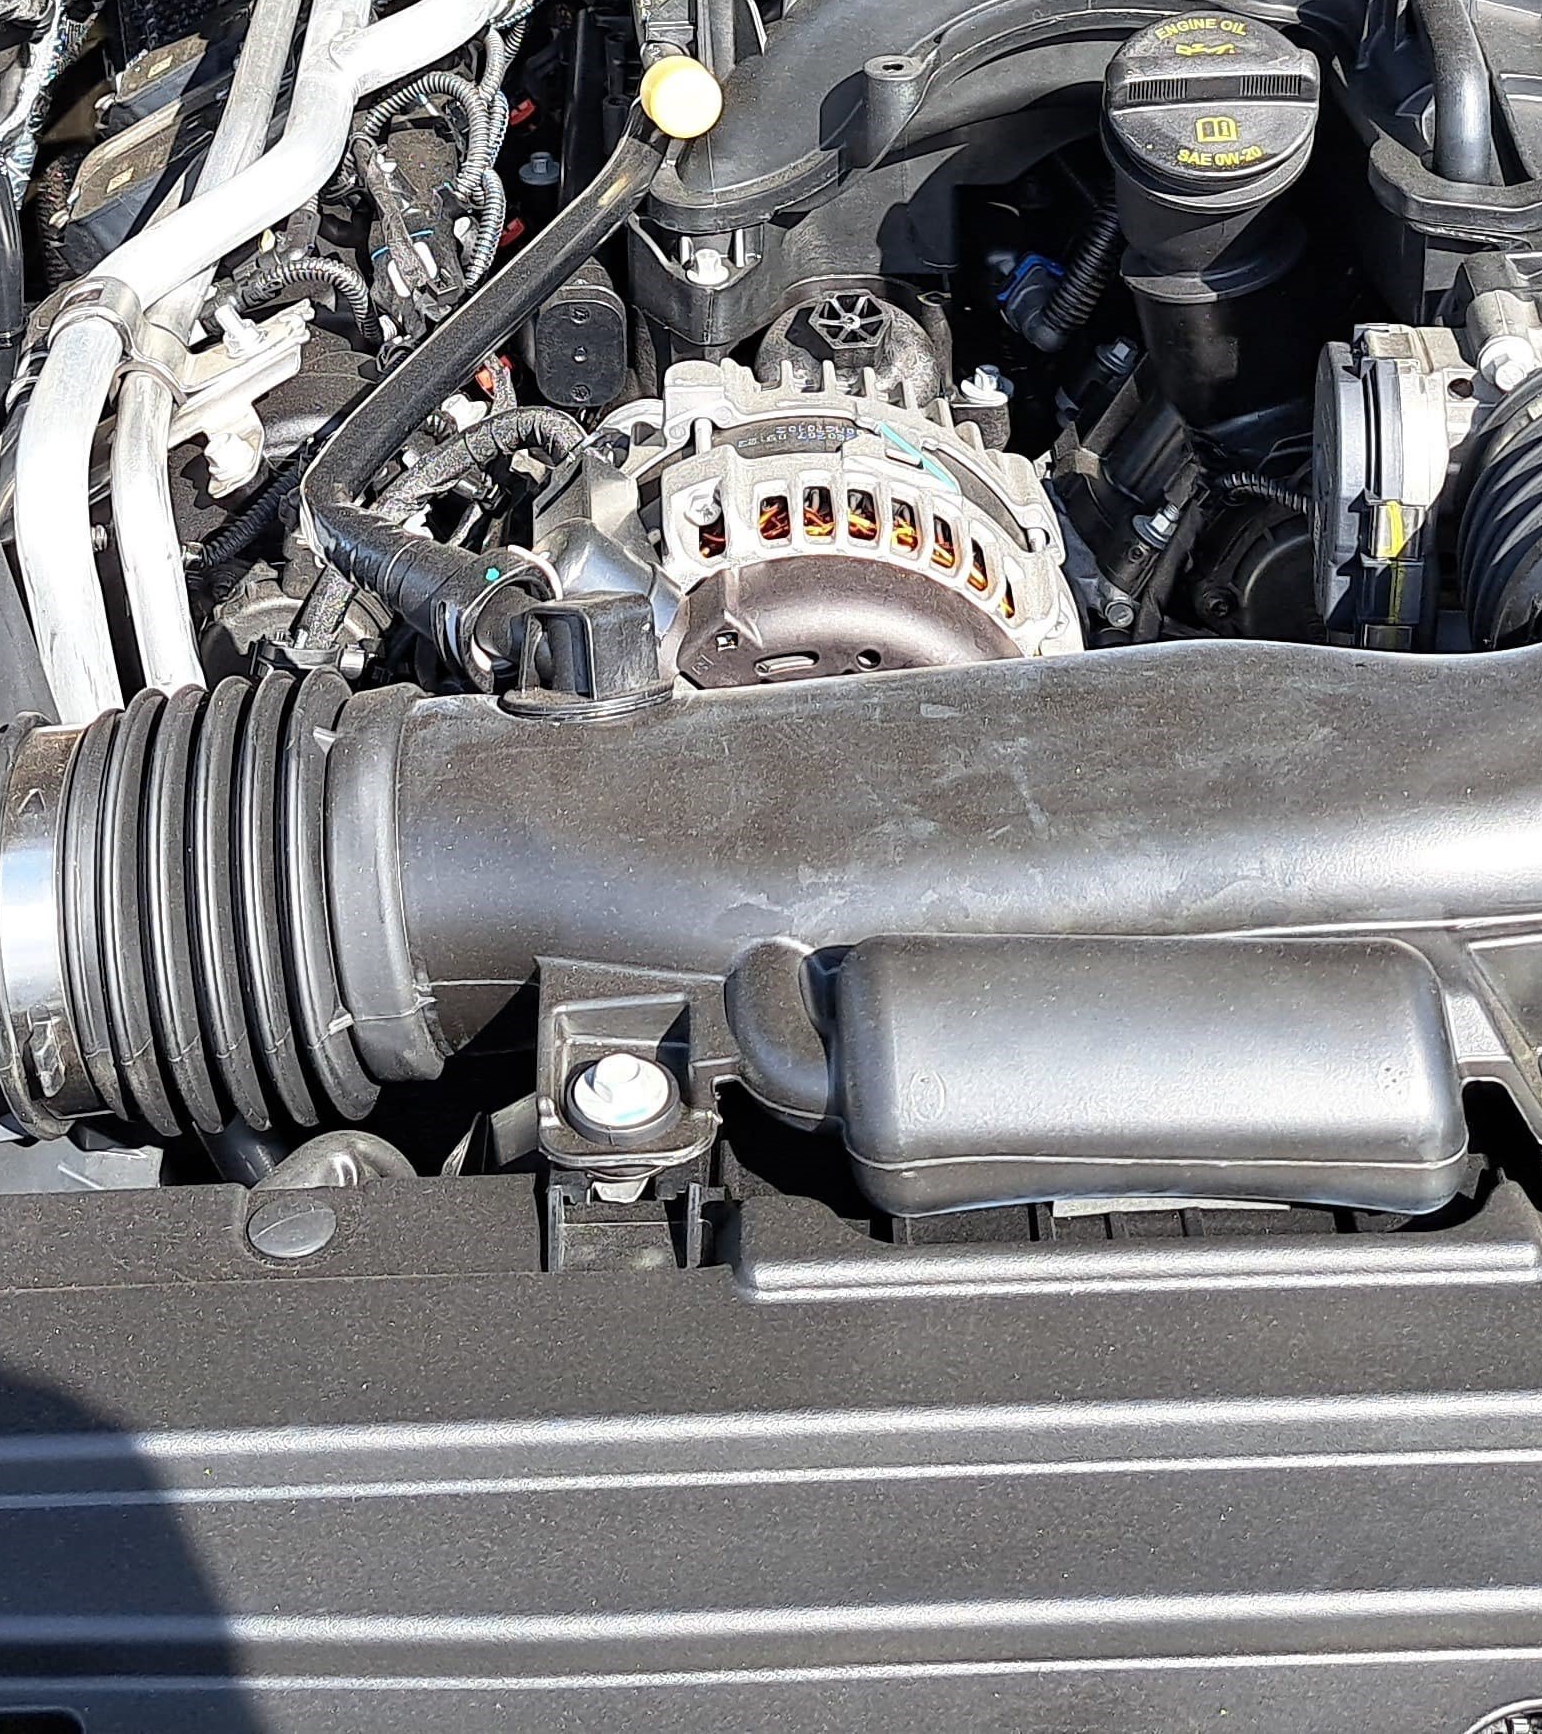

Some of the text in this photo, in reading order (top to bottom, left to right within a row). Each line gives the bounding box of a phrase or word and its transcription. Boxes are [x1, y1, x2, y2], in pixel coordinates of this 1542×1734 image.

[1154, 17, 1248, 40] ENGINE OIL
[1177, 145, 1263, 167] SAE 0W-20
